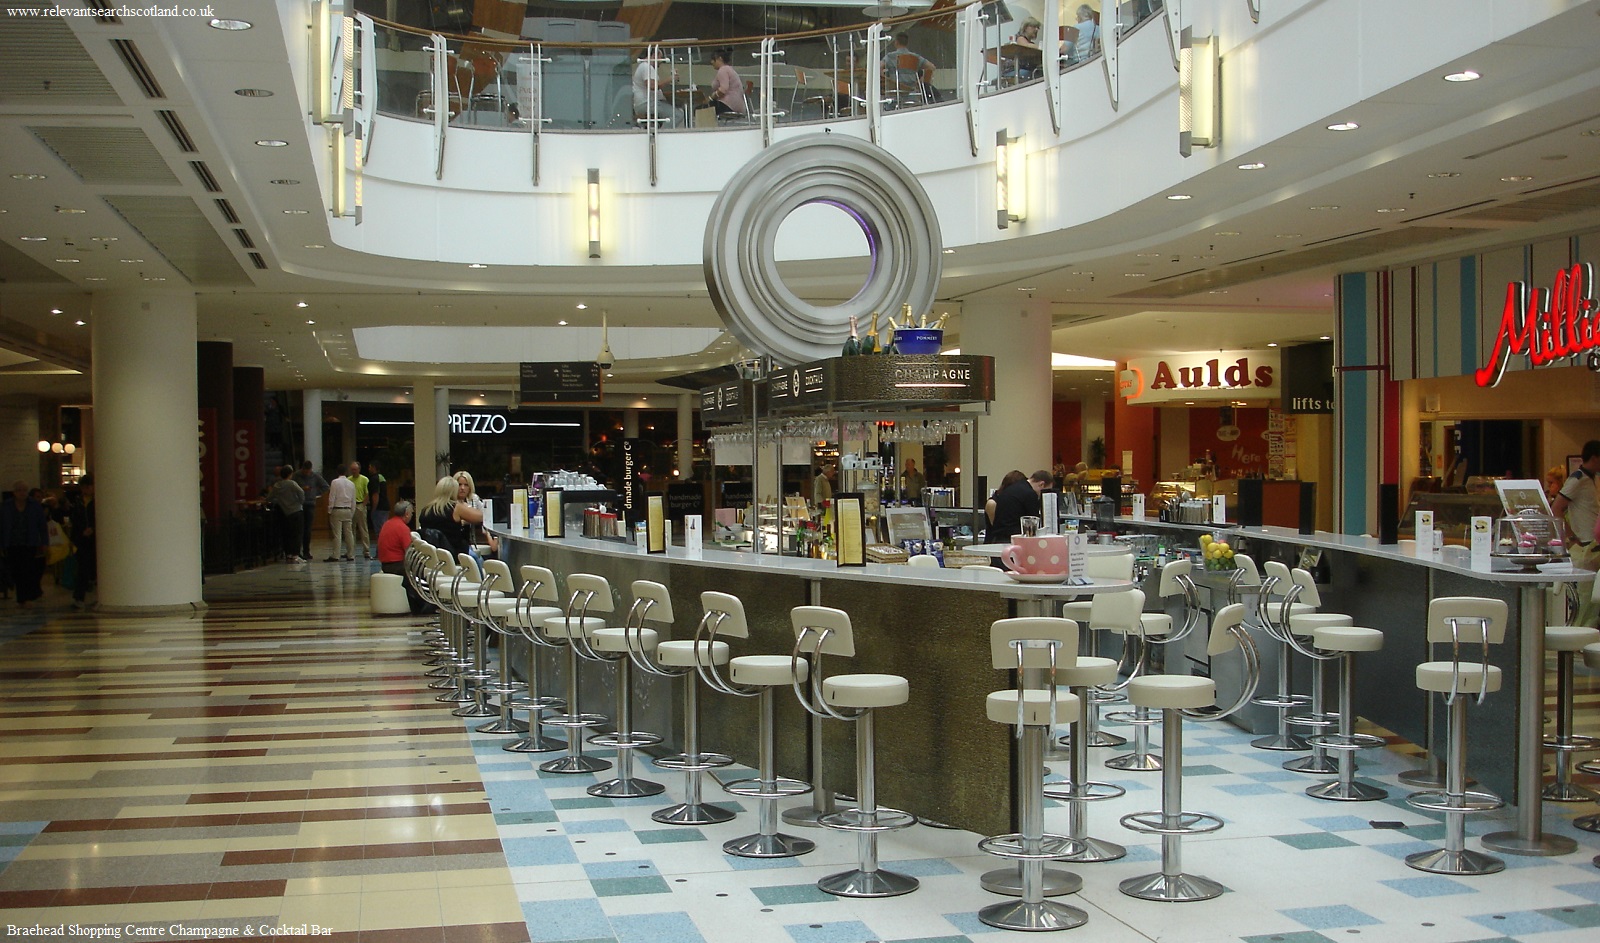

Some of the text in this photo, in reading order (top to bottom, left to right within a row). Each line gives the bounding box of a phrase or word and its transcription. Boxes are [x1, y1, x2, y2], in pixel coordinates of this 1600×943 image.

[895, 369, 971, 380] CHAMPAGNE
[1151, 357, 1274, 390] Aulds
[1292, 397, 1322, 410] lifts
[235, 429, 250, 503] COST
[623, 452, 634, 480] burger
[623, 481, 633, 510] dmade
